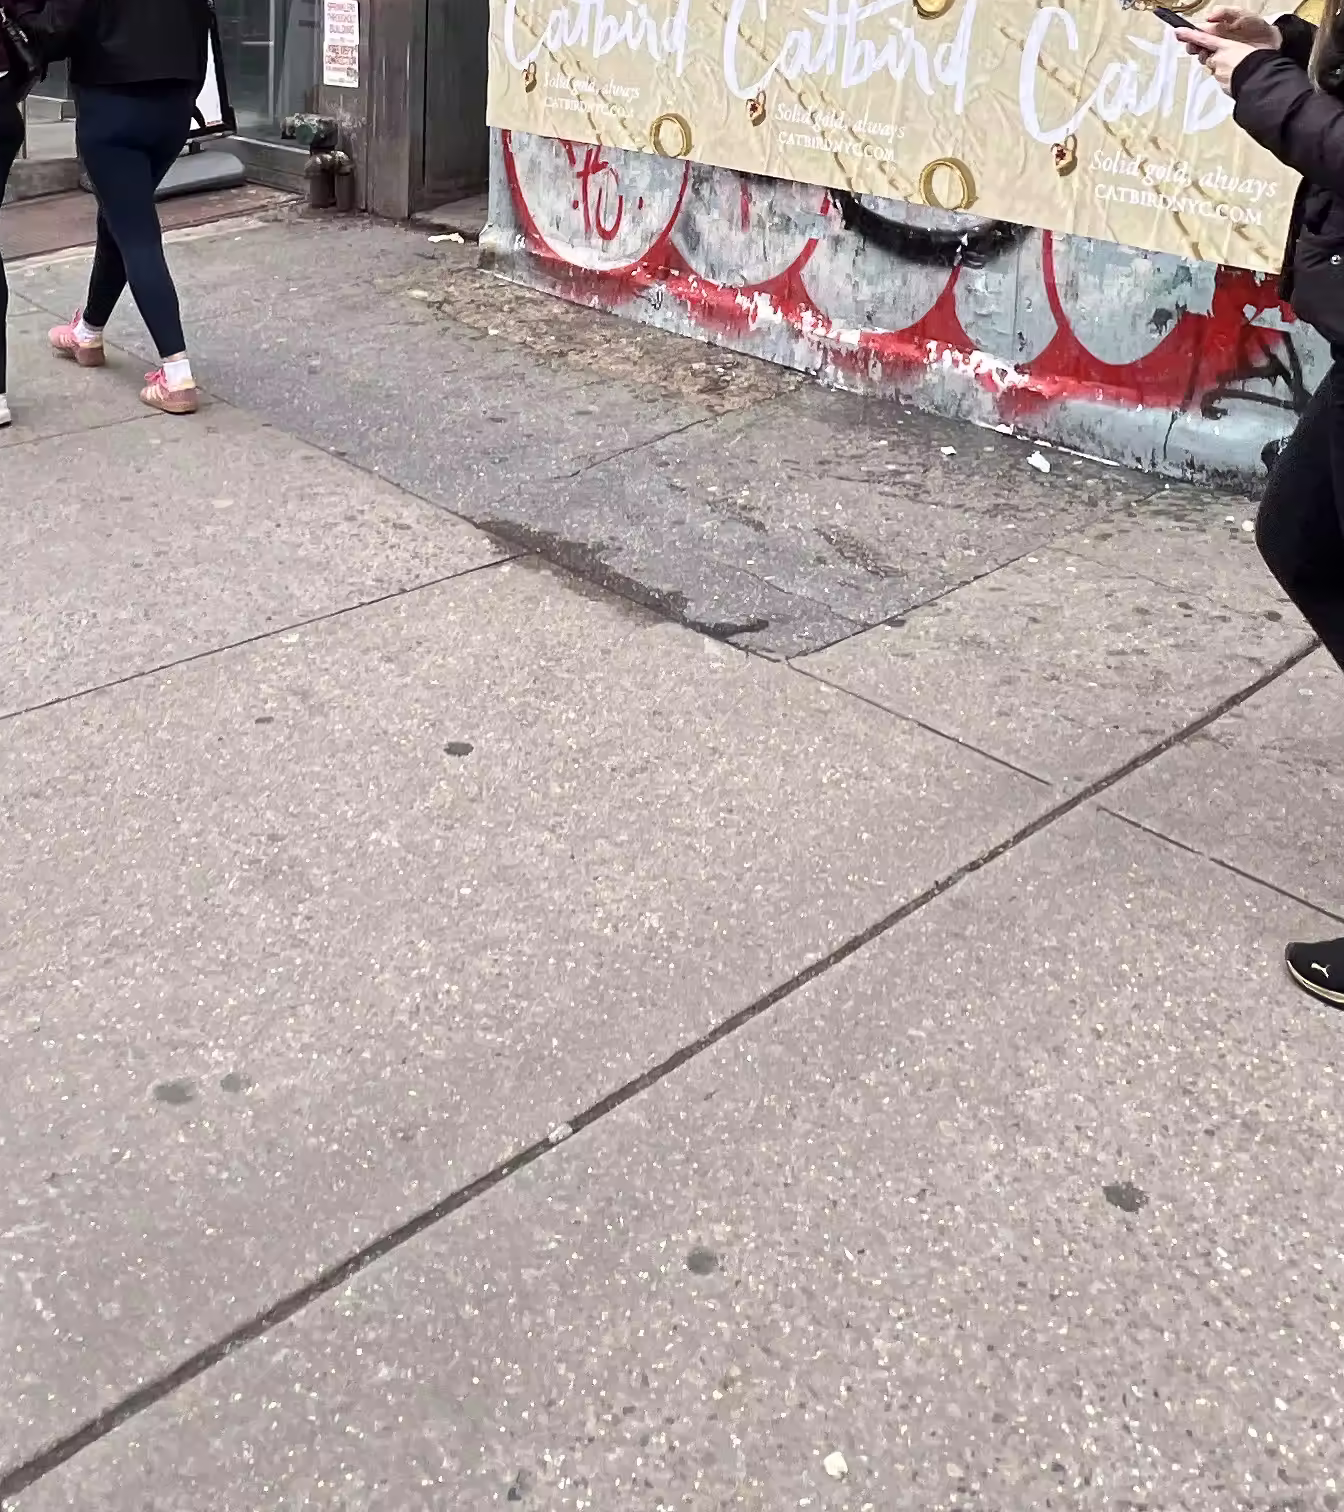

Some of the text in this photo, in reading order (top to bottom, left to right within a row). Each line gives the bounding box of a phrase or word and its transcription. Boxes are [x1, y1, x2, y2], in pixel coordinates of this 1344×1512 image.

[1019, 7, 1236, 144] Catb
[774, 101, 905, 144] Solid gold, always
[778, 131, 895, 162] CATBIRDNYC.COM
[1091, 149, 1279, 203] Solid gold, always
[1094, 183, 1263, 226] CATBIRDNYC.COM
